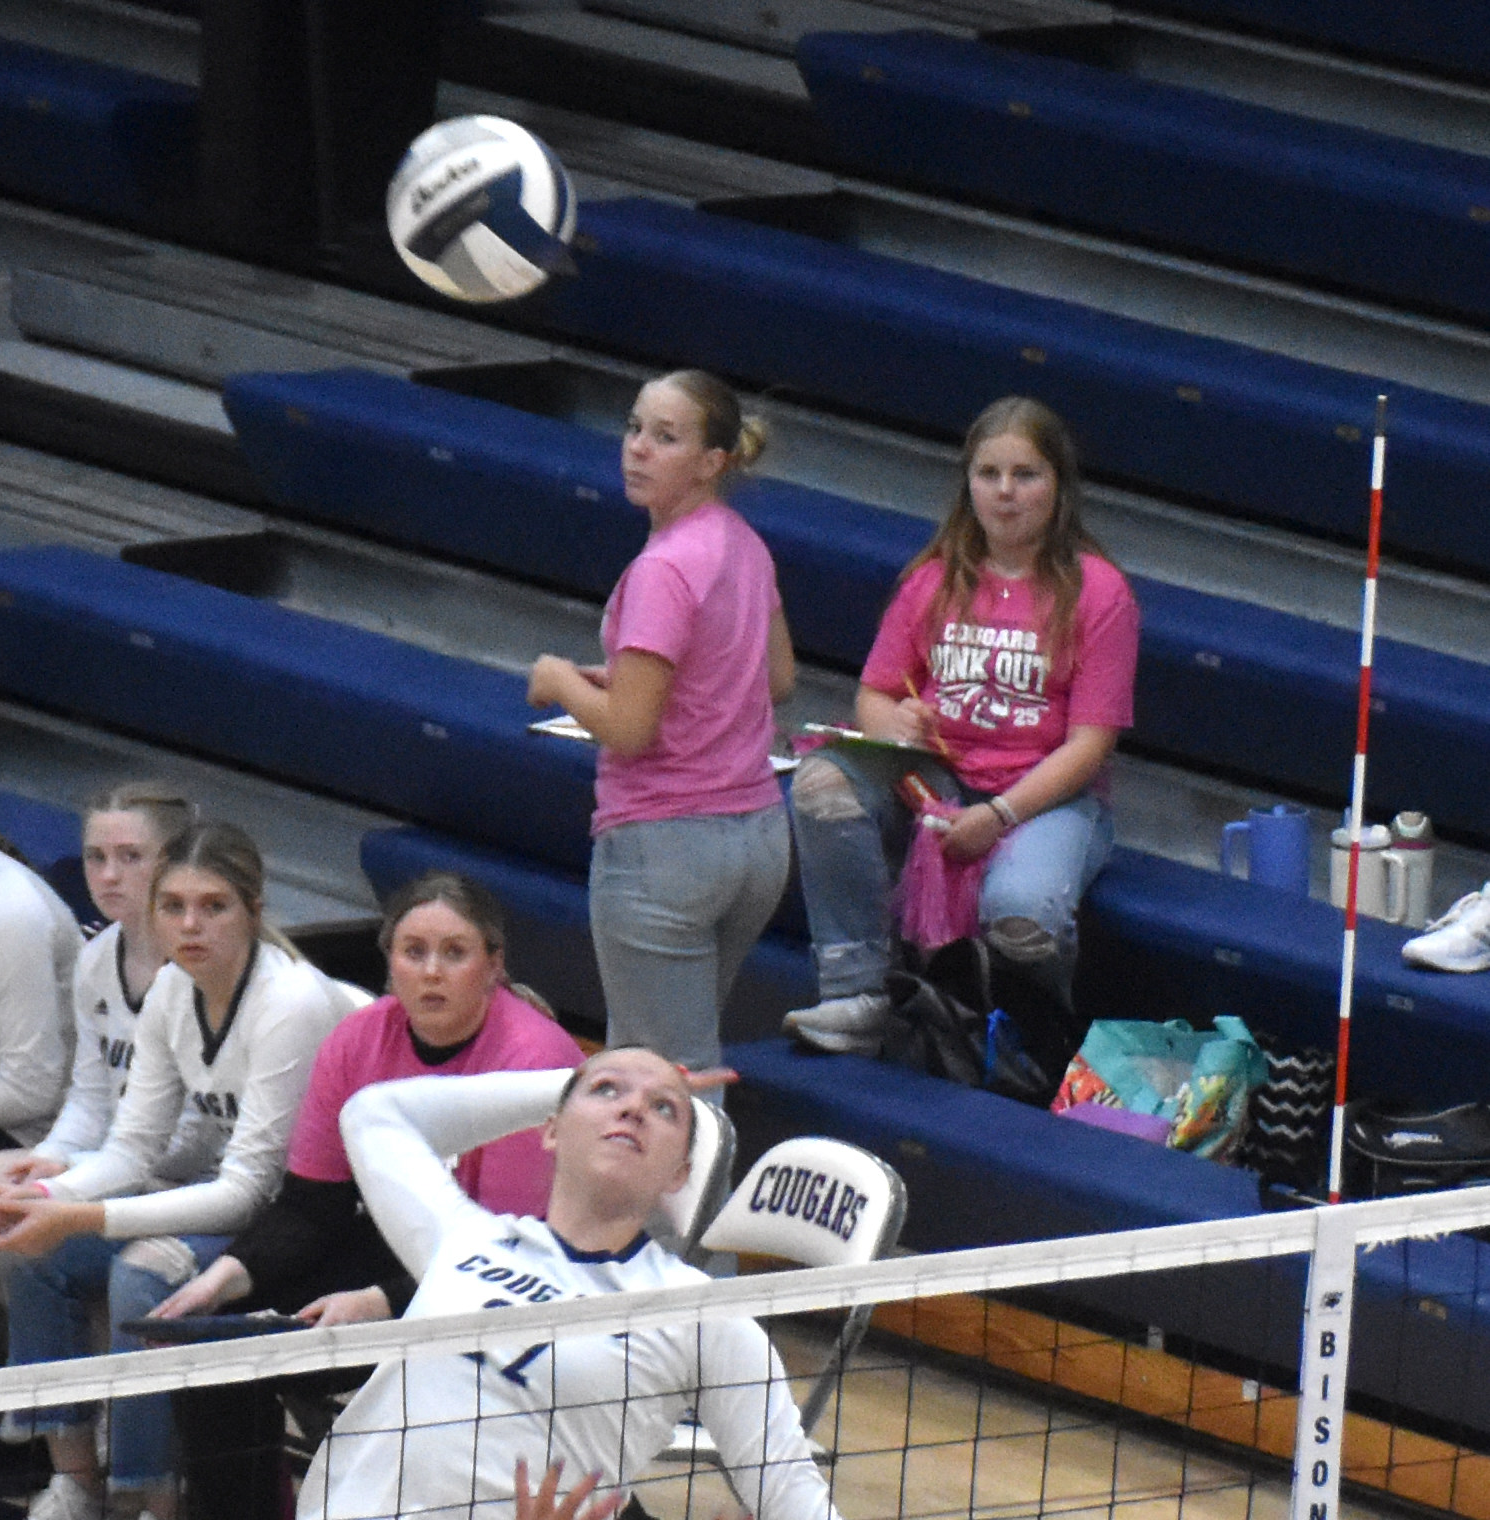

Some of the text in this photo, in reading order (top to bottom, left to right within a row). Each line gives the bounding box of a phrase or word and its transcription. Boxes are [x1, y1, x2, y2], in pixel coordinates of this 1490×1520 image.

[995, 650, 1046, 694] OUT
[750, 1163, 868, 1243] COUGARS
[454, 1253, 564, 1304] COUG
